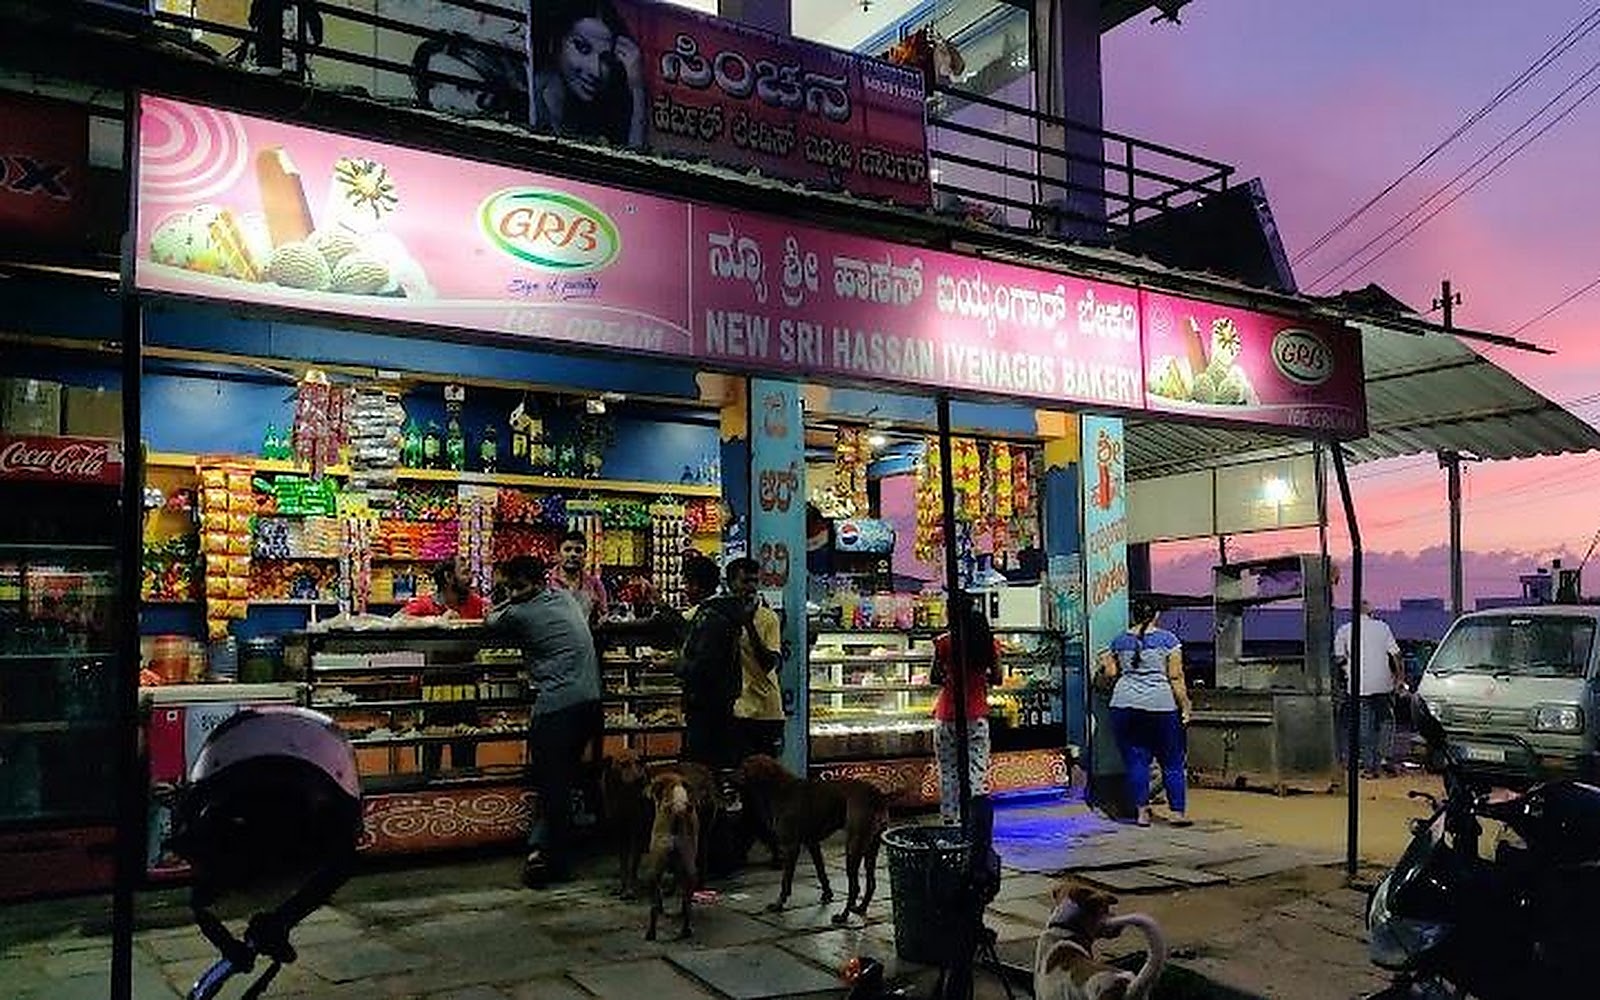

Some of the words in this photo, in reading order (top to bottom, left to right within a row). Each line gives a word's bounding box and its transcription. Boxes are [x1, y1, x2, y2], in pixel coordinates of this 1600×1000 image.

[660, 34, 850, 122] ಸಿಂಚನ
[708, 222, 769, 304] ನ್ಯೂ
[780, 234, 819, 307] ಶ್ರೀ
[833, 253, 924, 303] ಹಾಸನ್
[1078, 289, 1138, 342] ಬೇಕರಿ
[706, 310, 770, 358] NEW
[779, 319, 824, 366] SRI
[832, 328, 934, 381] HASSAN
[942, 340, 1056, 393] IYENAGRS
[1063, 356, 1142, 403] BAKERY
